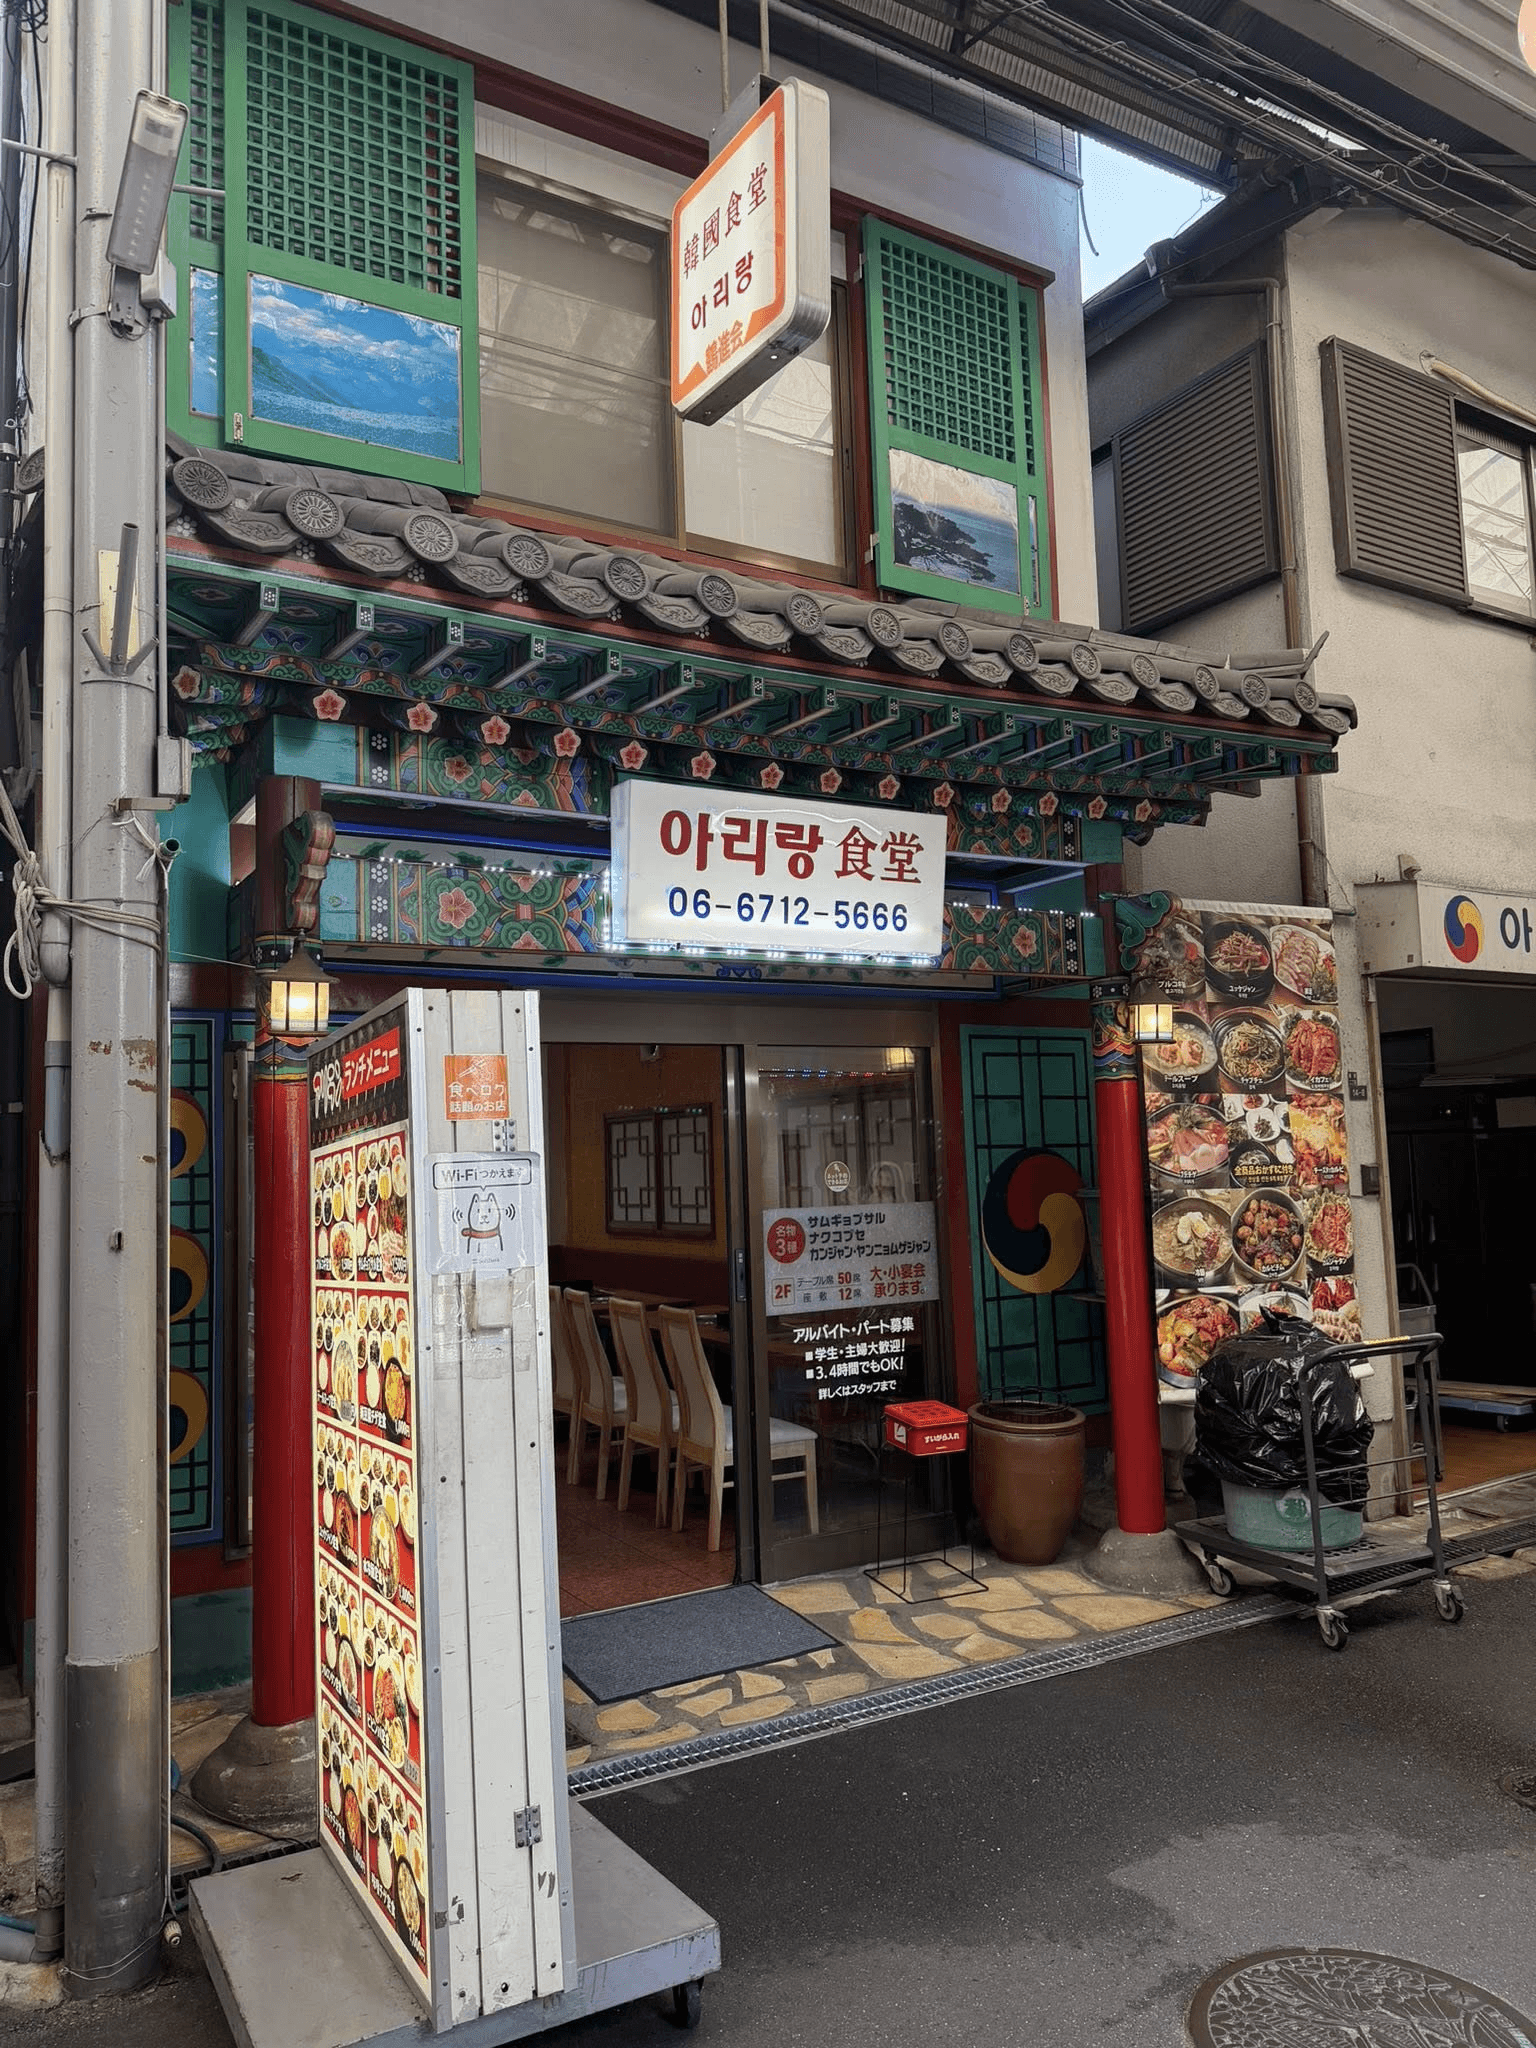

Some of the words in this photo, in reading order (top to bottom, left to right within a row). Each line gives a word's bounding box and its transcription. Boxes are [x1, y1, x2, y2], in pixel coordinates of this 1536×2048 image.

[682, 162, 768, 278] 韓國食堂
[691, 251, 754, 330] 아리랑
[660, 810, 824, 880] 아리랑
[835, 825, 925, 884] 食堂
[668, 886, 908, 932] 06-6712-5666
[344, 1048, 399, 1092] ランチメニュー
[774, 1284, 792, 1301] 2F
[873, 1280, 928, 1299] 承ります。
[792, 1316, 915, 1344] アルバイト・パート募集
[817, 1378, 898, 1401] 詳しくはスタッフまで
